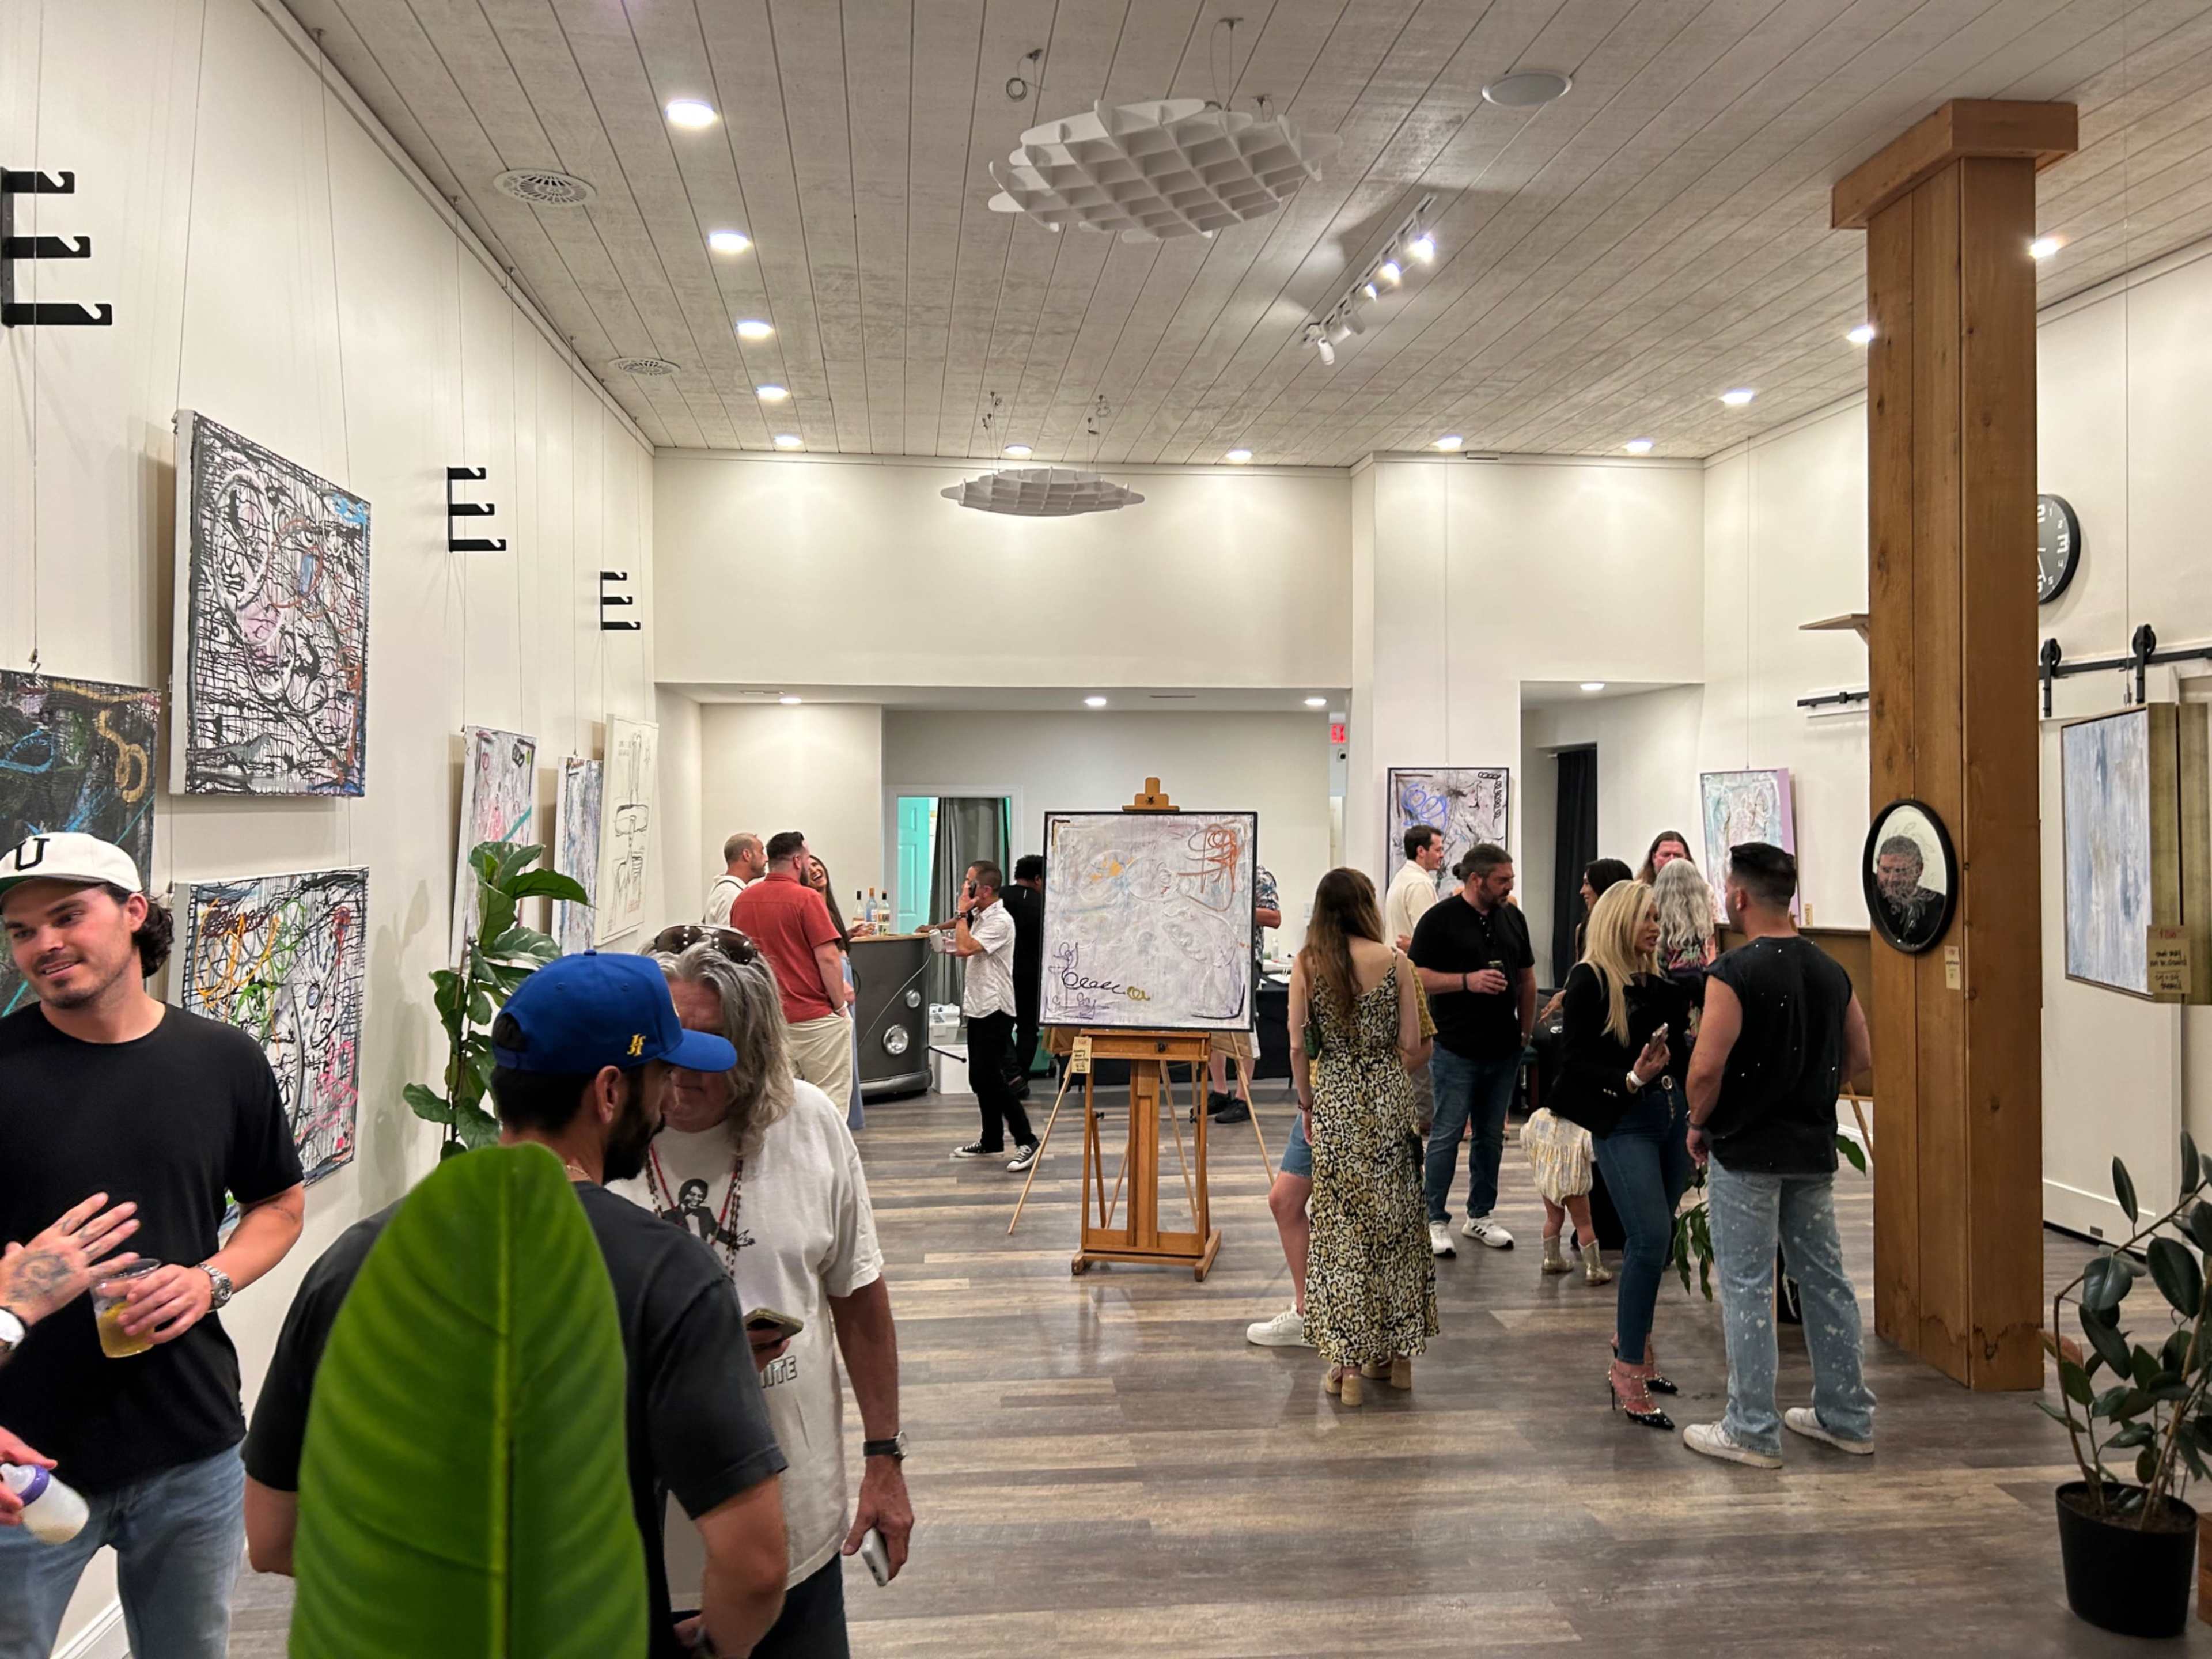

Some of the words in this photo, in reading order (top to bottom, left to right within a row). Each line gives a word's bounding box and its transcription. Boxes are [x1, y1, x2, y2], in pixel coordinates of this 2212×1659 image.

[2057, 520, 2063, 529] 2
[2057, 533, 2069, 554] 3
[2048, 576, 2054, 585] 5
[14, 838, 50, 871] U
[627, 1034, 646, 1056] H
[761, 1355, 798, 1388] ITE
